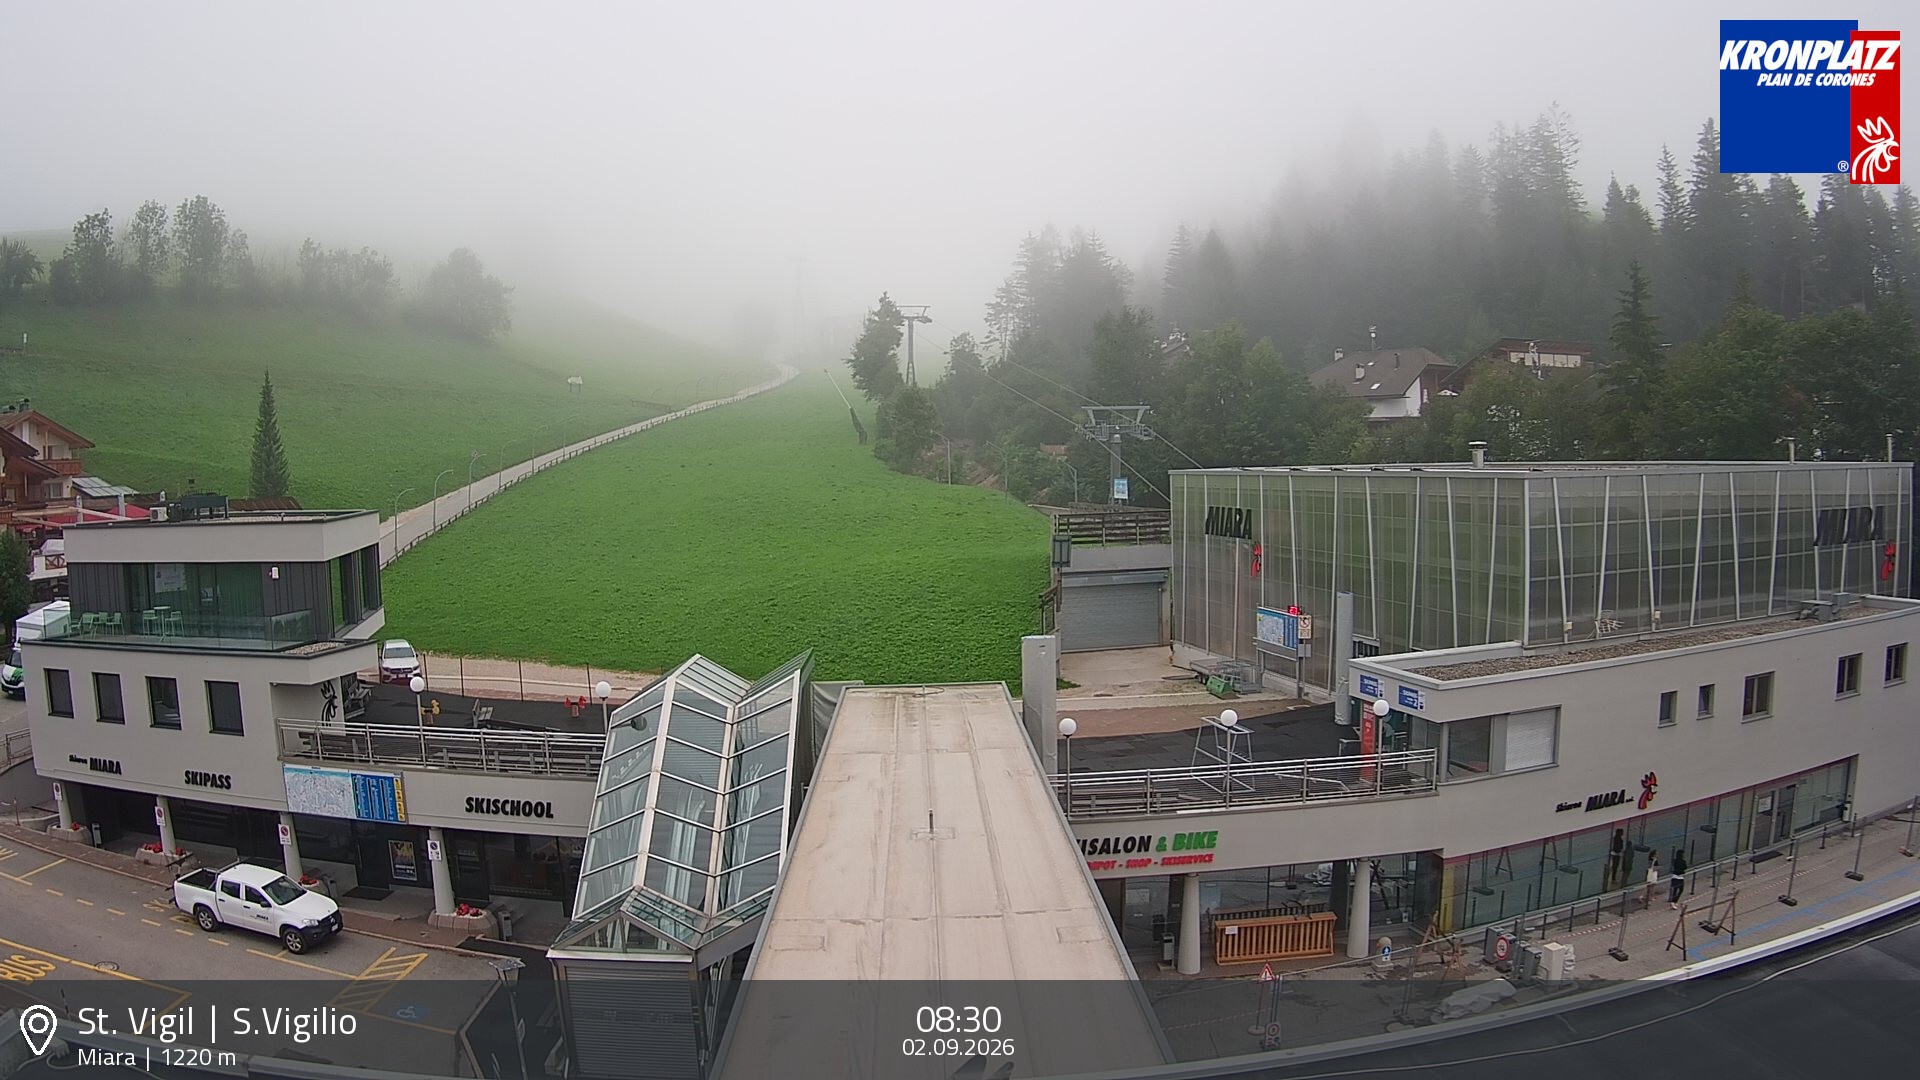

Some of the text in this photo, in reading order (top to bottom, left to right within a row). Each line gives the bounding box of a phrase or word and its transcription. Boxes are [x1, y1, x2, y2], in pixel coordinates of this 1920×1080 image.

[1205, 506, 1252, 540] MIARA
[1813, 505, 1884, 547] MIARA
[90, 757, 122, 775] MIARA
[184, 770, 232, 790] SKIPASS
[465, 796, 554, 819] SKISCHOOL
[1585, 789, 1626, 812] MIARA
[1156, 836, 1168, 852] &
[1172, 830, 1219, 851] BIKE
[1126, 857, 1152, 869] SHOP
[0, 955, 56, 985] BUS
